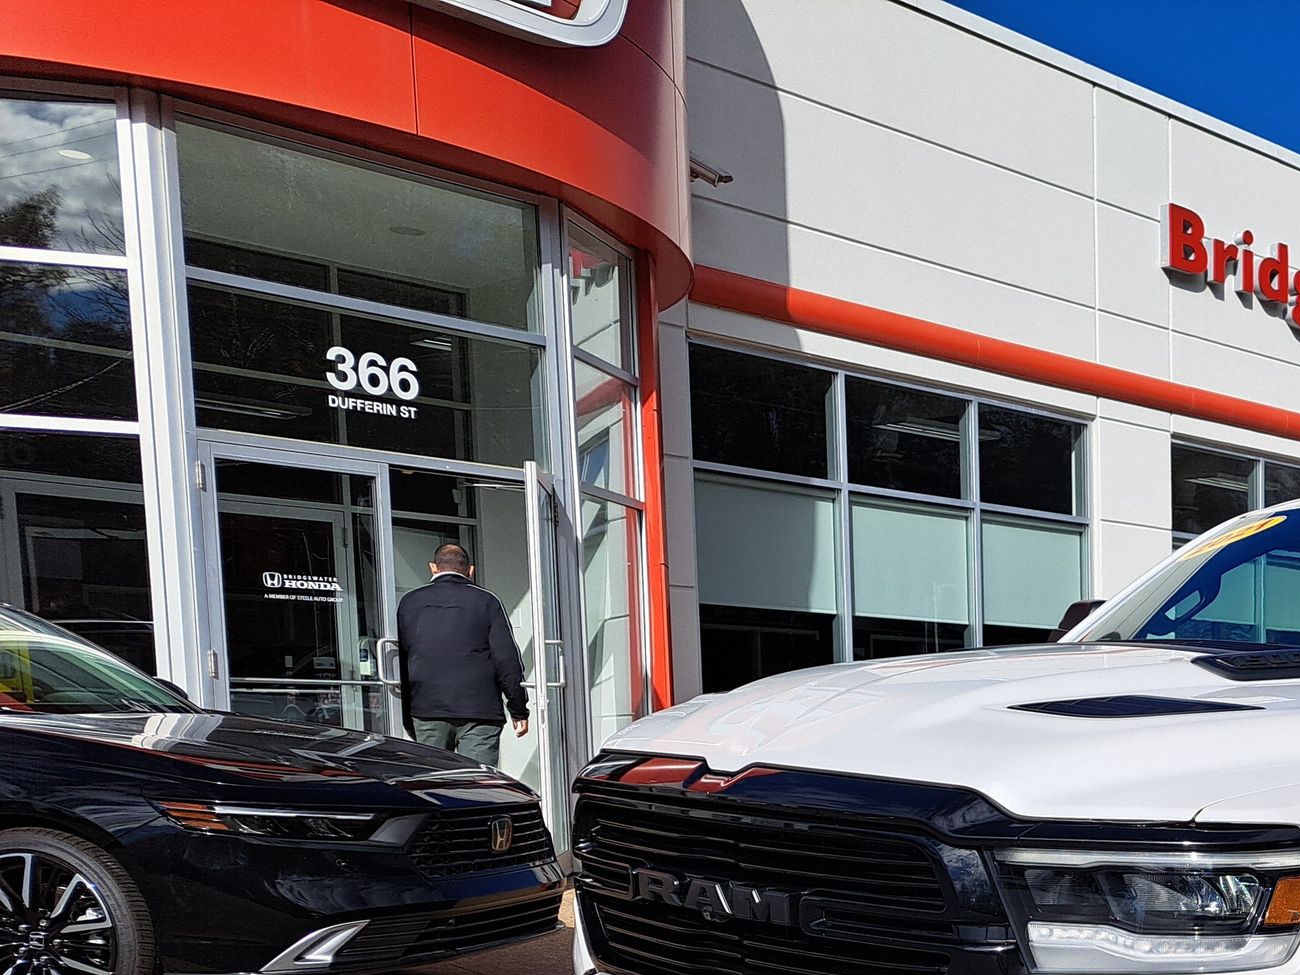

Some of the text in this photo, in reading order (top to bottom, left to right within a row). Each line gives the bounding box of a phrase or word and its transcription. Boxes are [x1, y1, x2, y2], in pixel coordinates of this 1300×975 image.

[325, 346, 420, 401] 366
[328, 394, 418, 419] DUFFERIN ST
[283, 574, 338, 582] BRIDGEWATER
[283, 580, 344, 591] HONDA
[635, 867, 791, 927] RAM
